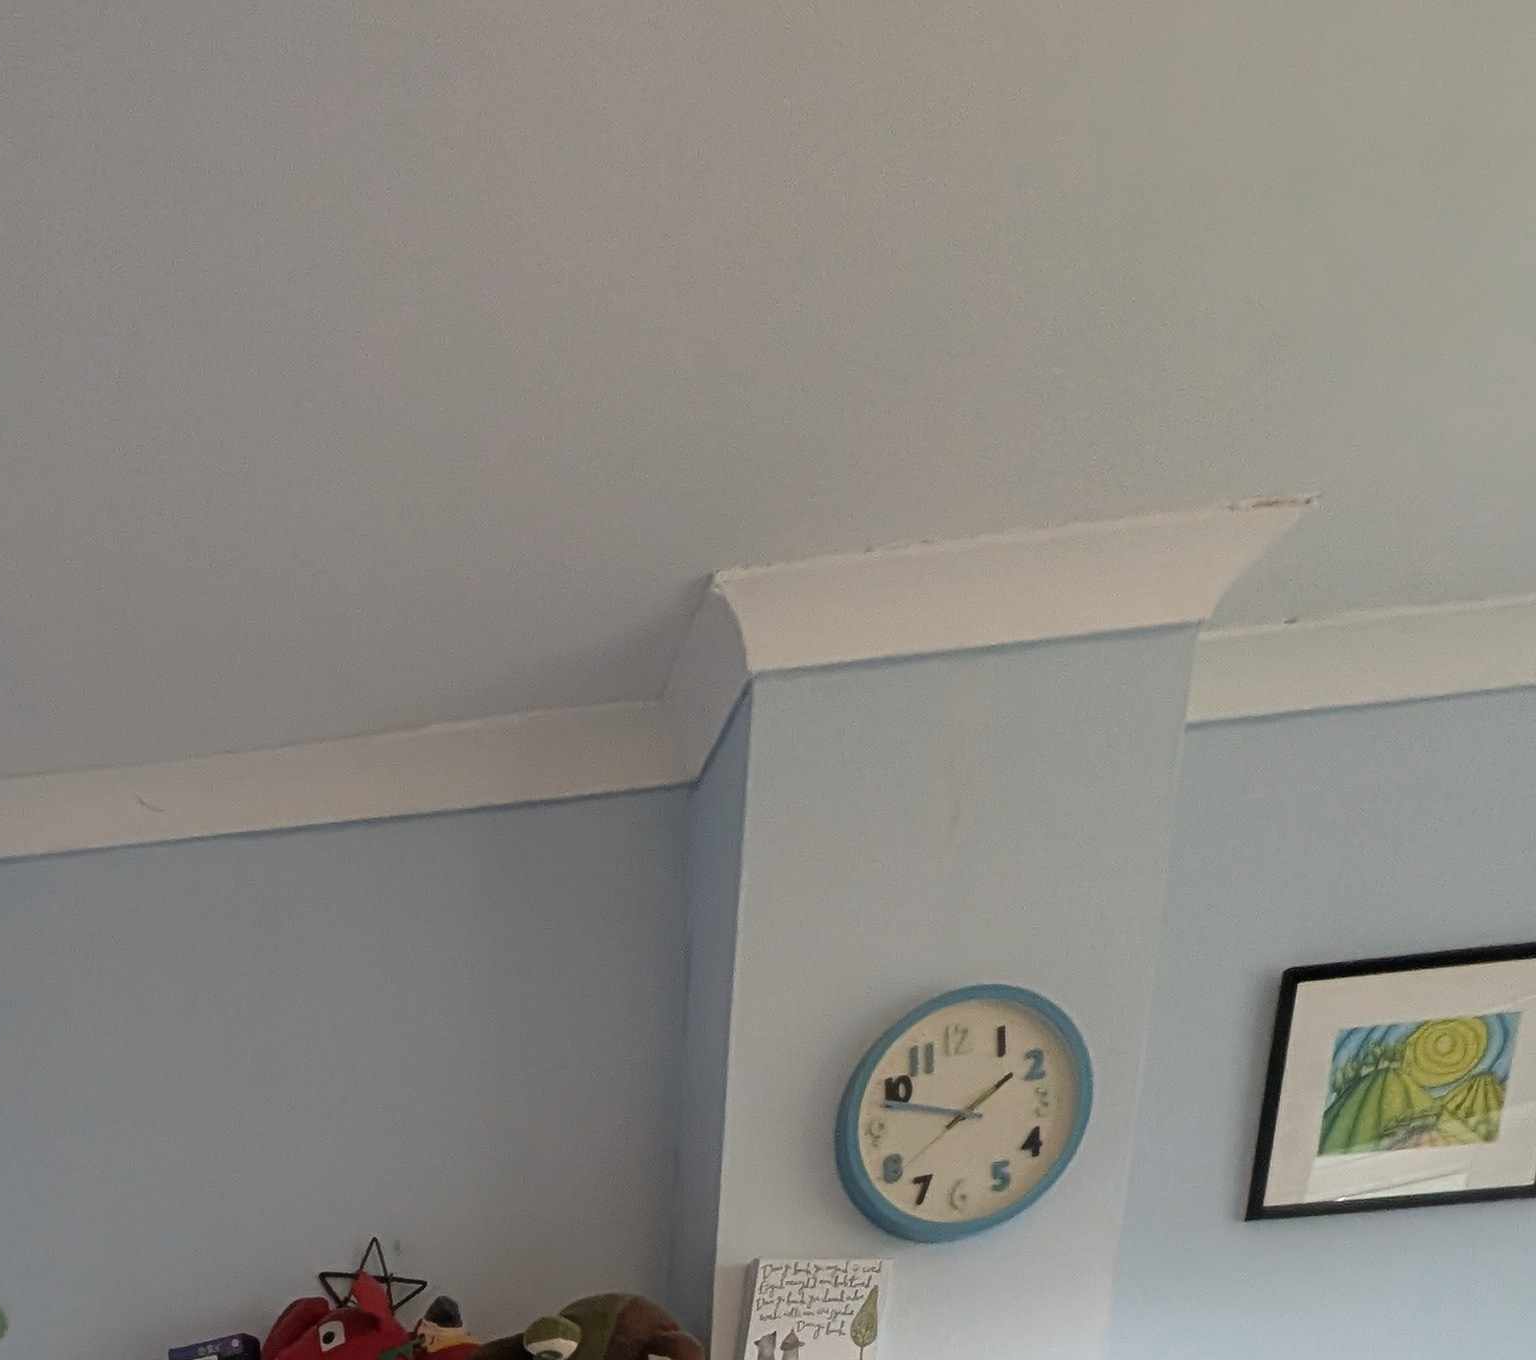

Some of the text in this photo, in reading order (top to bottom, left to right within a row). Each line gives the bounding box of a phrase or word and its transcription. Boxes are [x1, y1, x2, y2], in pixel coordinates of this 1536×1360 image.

[996, 1025, 1006, 1058] 1
[909, 1042, 935, 1078] 11
[1023, 1047, 1046, 1081] 2
[884, 1074, 913, 1104] 10
[1020, 1125, 1043, 1158] 4
[912, 1173, 934, 1206] 7
[991, 1160, 1011, 1192] 5
